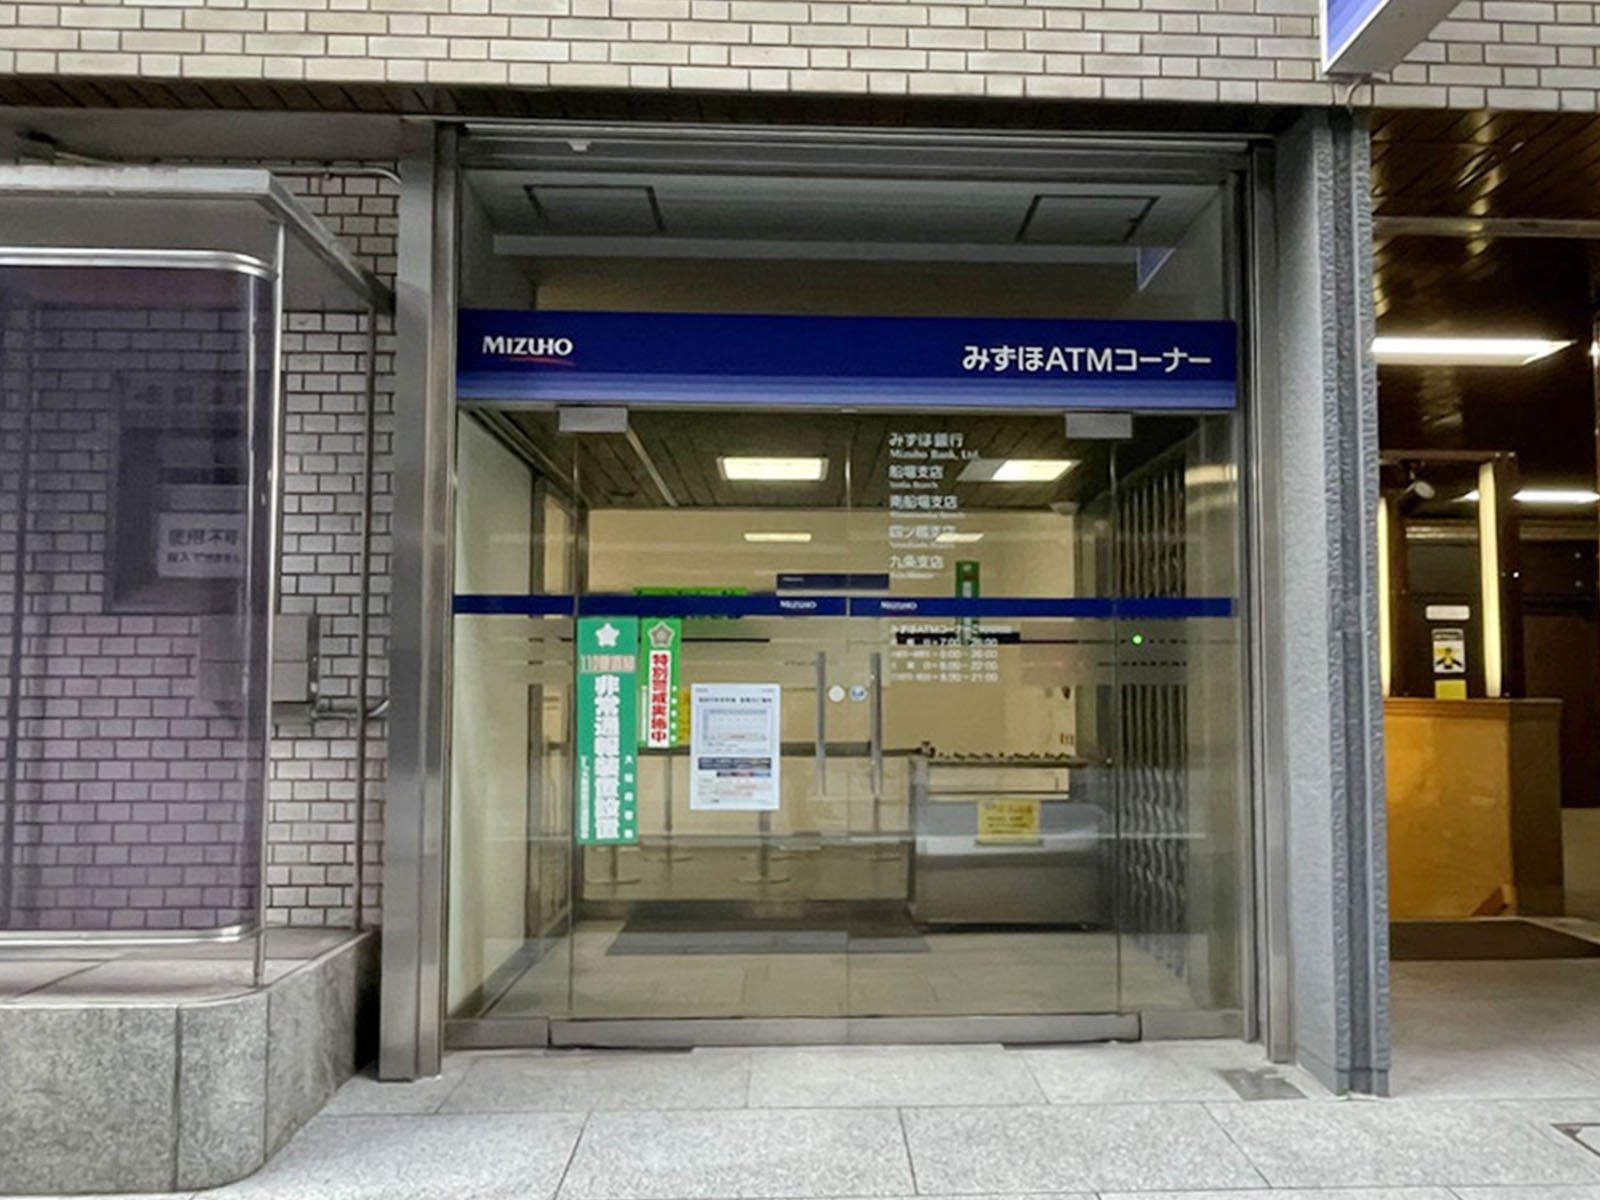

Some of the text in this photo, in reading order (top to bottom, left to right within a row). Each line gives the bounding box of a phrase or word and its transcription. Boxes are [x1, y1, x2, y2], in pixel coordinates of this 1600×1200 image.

[482, 335, 574, 356] MIZUHO
[962, 345, 1212, 373] みずほATMコーナー
[889, 432, 964, 448] みずほ銀行
[169, 529, 239, 546] 使用不可
[780, 600, 817, 610] MIZUHO
[881, 601, 918, 611] MIZUHO
